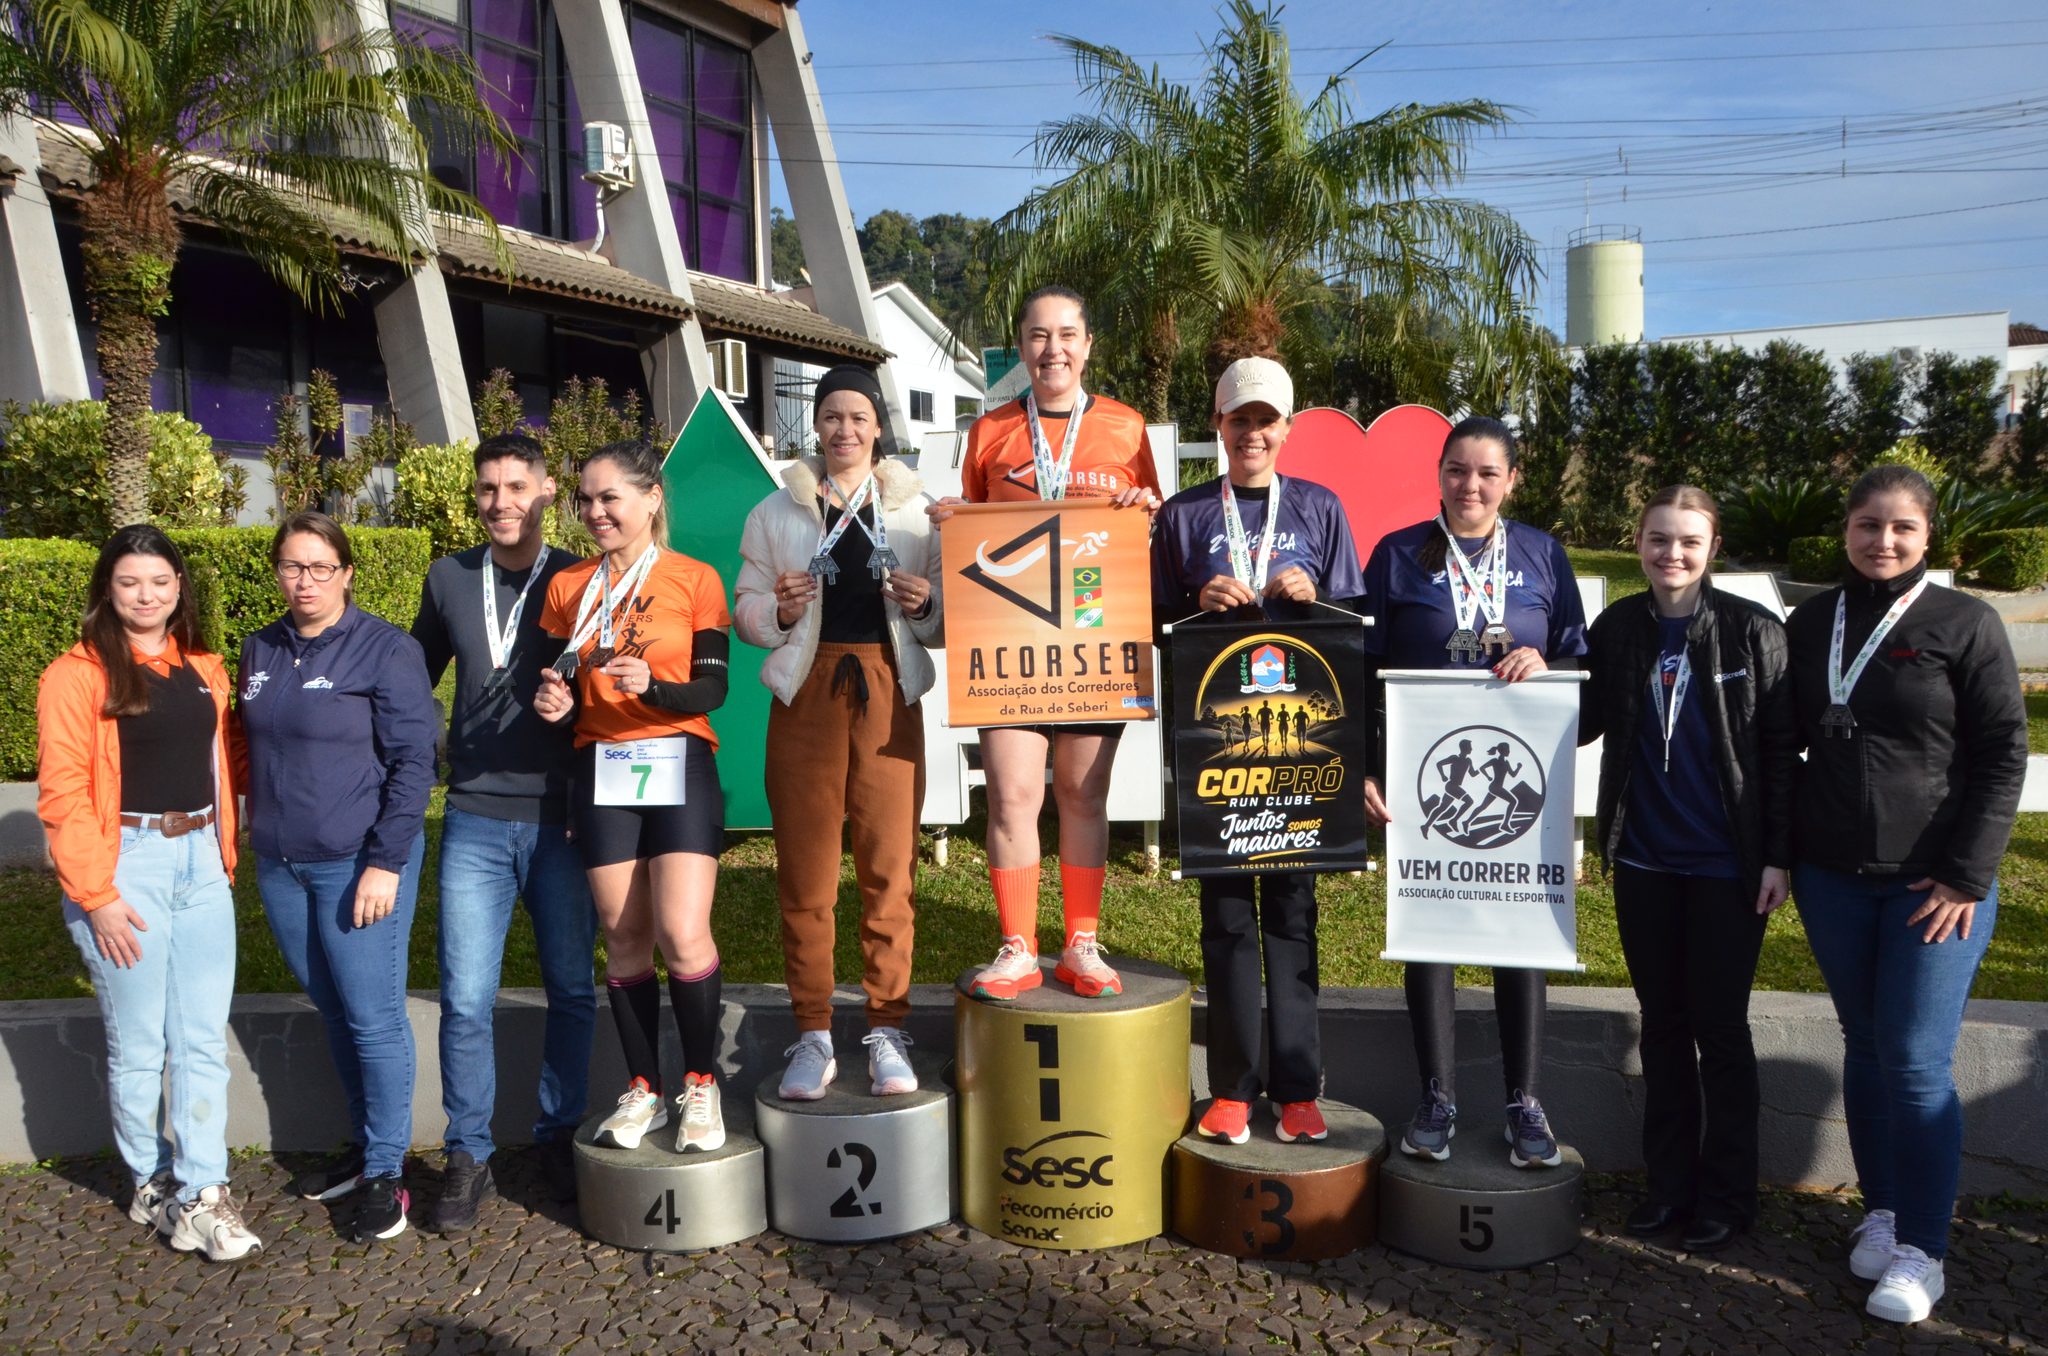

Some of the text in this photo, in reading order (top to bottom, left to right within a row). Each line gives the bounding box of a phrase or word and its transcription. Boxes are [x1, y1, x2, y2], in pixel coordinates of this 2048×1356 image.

[1065, 471, 1117, 489] ORSEB
[1227, 515, 1235, 539] CRESOL
[969, 641, 1139, 680] ACORSEB
[1721, 668, 1746, 680] Sicredi
[967, 680, 1140, 699] Associação dos Corredores
[999, 701, 1108, 716] de Rua de Seberi
[604, 749, 633, 760] Sesc
[631, 765, 652, 799] 7
[1197, 757, 1344, 797] CORPRÓ
[1229, 795, 1312, 808] RUN CLUBE
[1220, 809, 1322, 839] Juntos somos
[1227, 830, 1321, 855] maiores.
[1240, 862, 1275, 870] VICENTE
[1398, 859, 1565, 885] VEM CORRER RB
[1398, 887, 1565, 905] ASSOCIAÇÃO CULTURAL E ESPORTIVA
[1024, 1023, 1060, 1122] 1
[827, 1142, 882, 1218] 2
[1001, 1147, 1114, 1188] Sesc
[643, 1189, 681, 1234] 4
[1243, 1179, 1297, 1256] 3
[1001, 1219, 1060, 1242] Senac
[1458, 1205, 1494, 1253] 5
